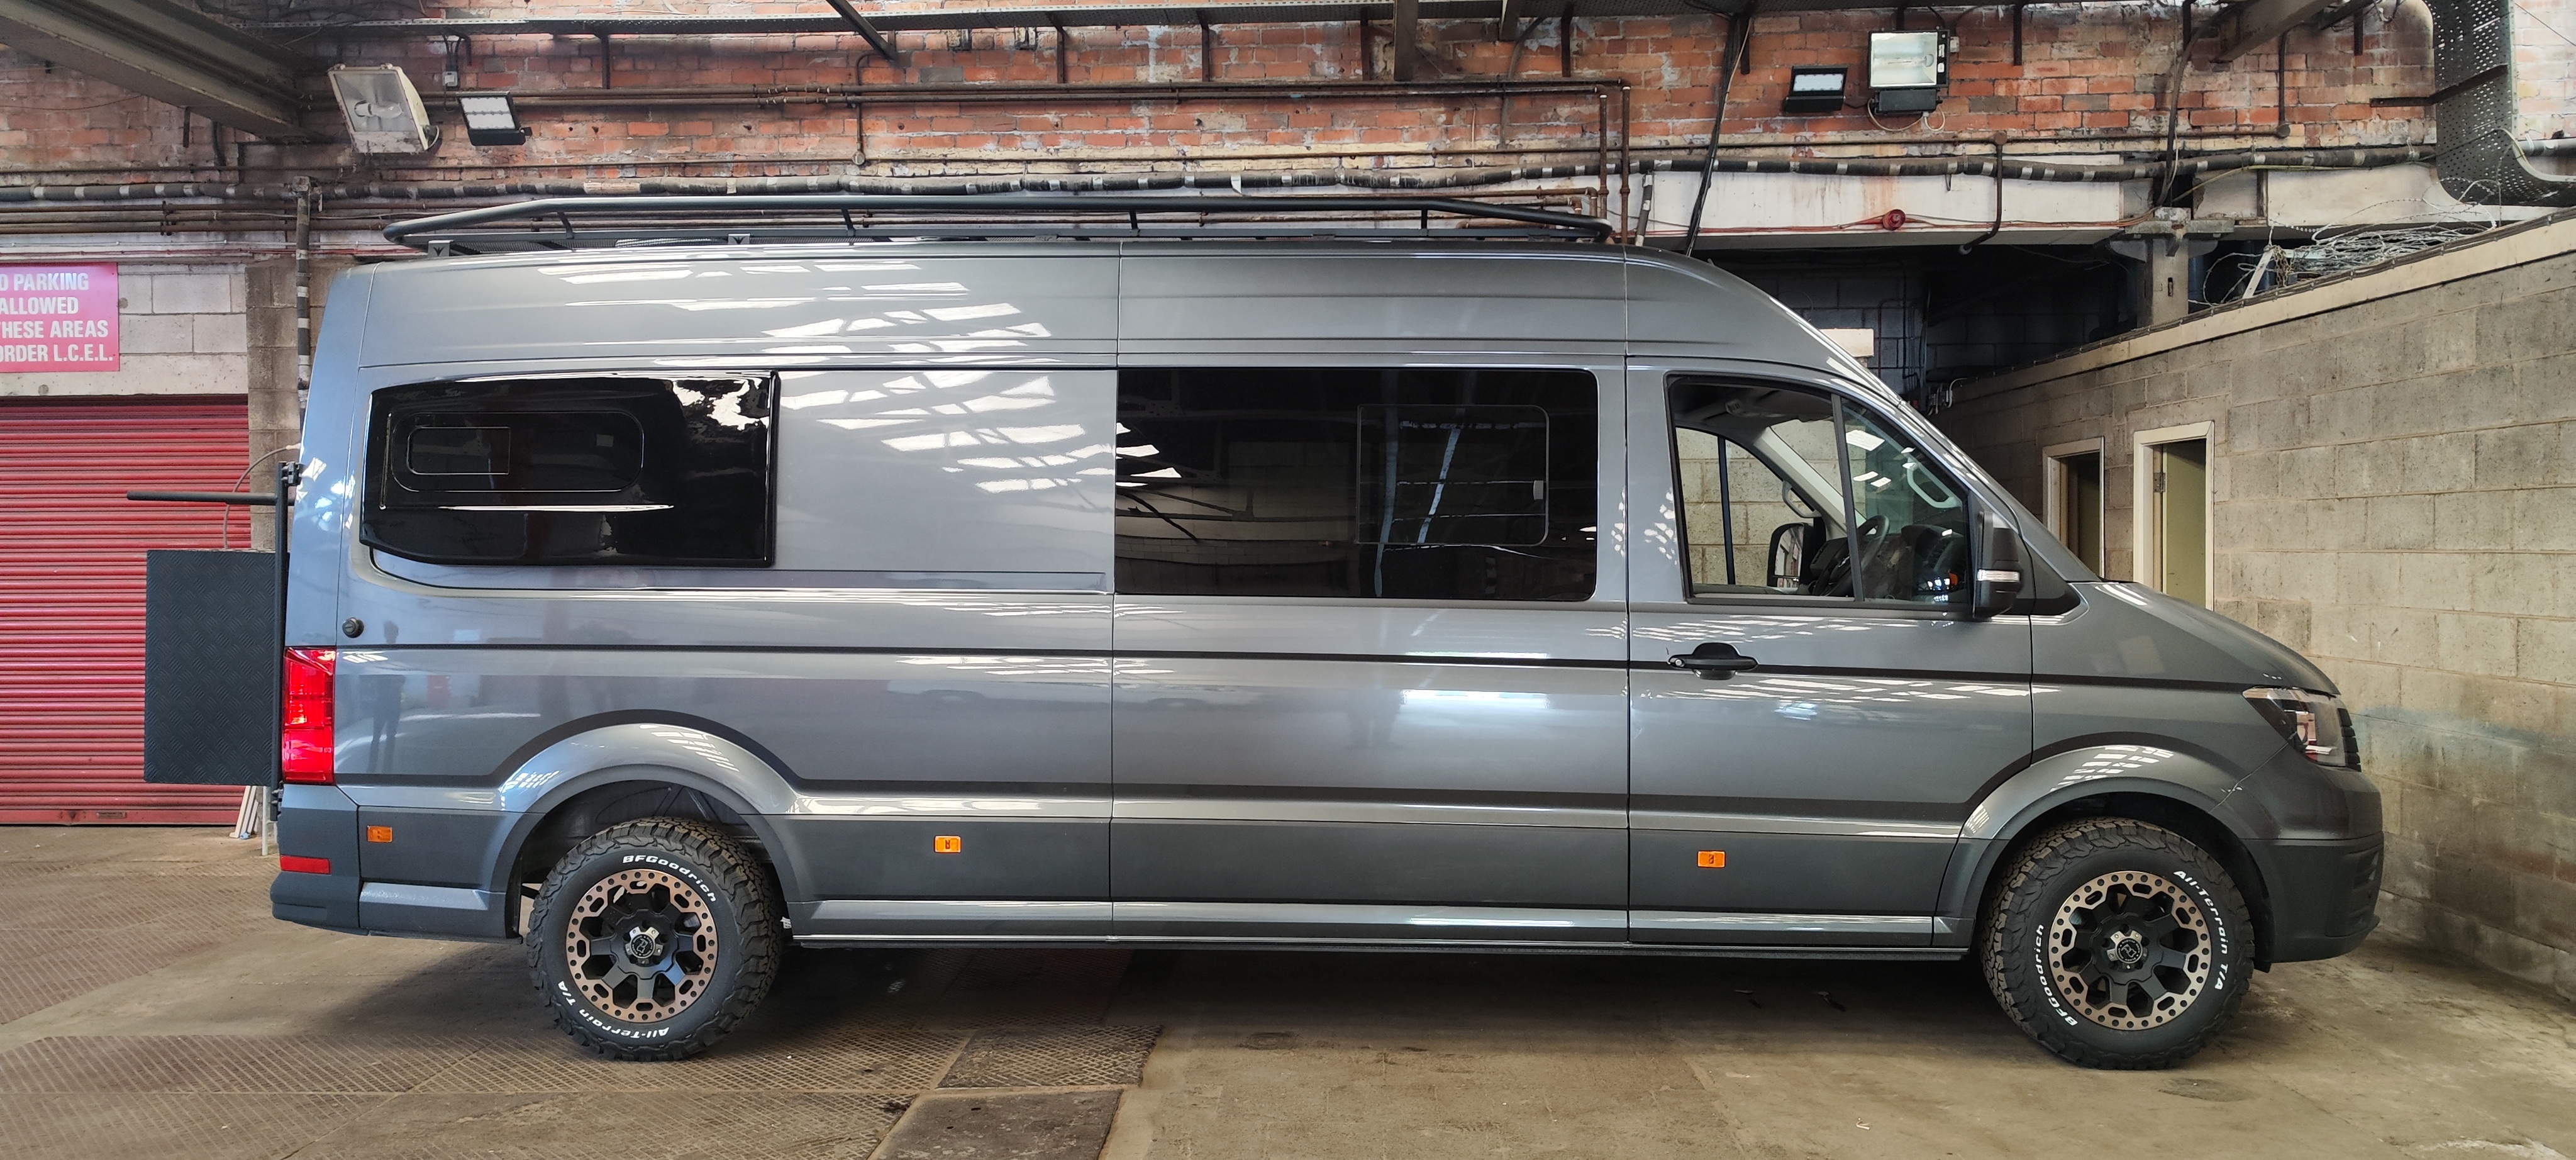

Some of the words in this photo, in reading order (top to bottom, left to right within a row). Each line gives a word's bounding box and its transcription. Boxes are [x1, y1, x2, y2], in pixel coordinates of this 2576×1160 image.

[14, 272, 89, 291] PARKING
[0, 296, 79, 315] ALLOWED
[0, 320, 44, 338] HESE
[50, 320, 109, 338] AREAS
[53, 343, 113, 362] L.C.E.L.
[623, 854, 716, 902] BFGoodrich
[2173, 871, 2228, 954] All-Terrain
[2214, 963, 2229, 990] T/A
[2034, 924, 2078, 1026] BFGoodrich
[557, 980, 576, 1006] T/A
[579, 1008, 670, 1039] All-Terrain
